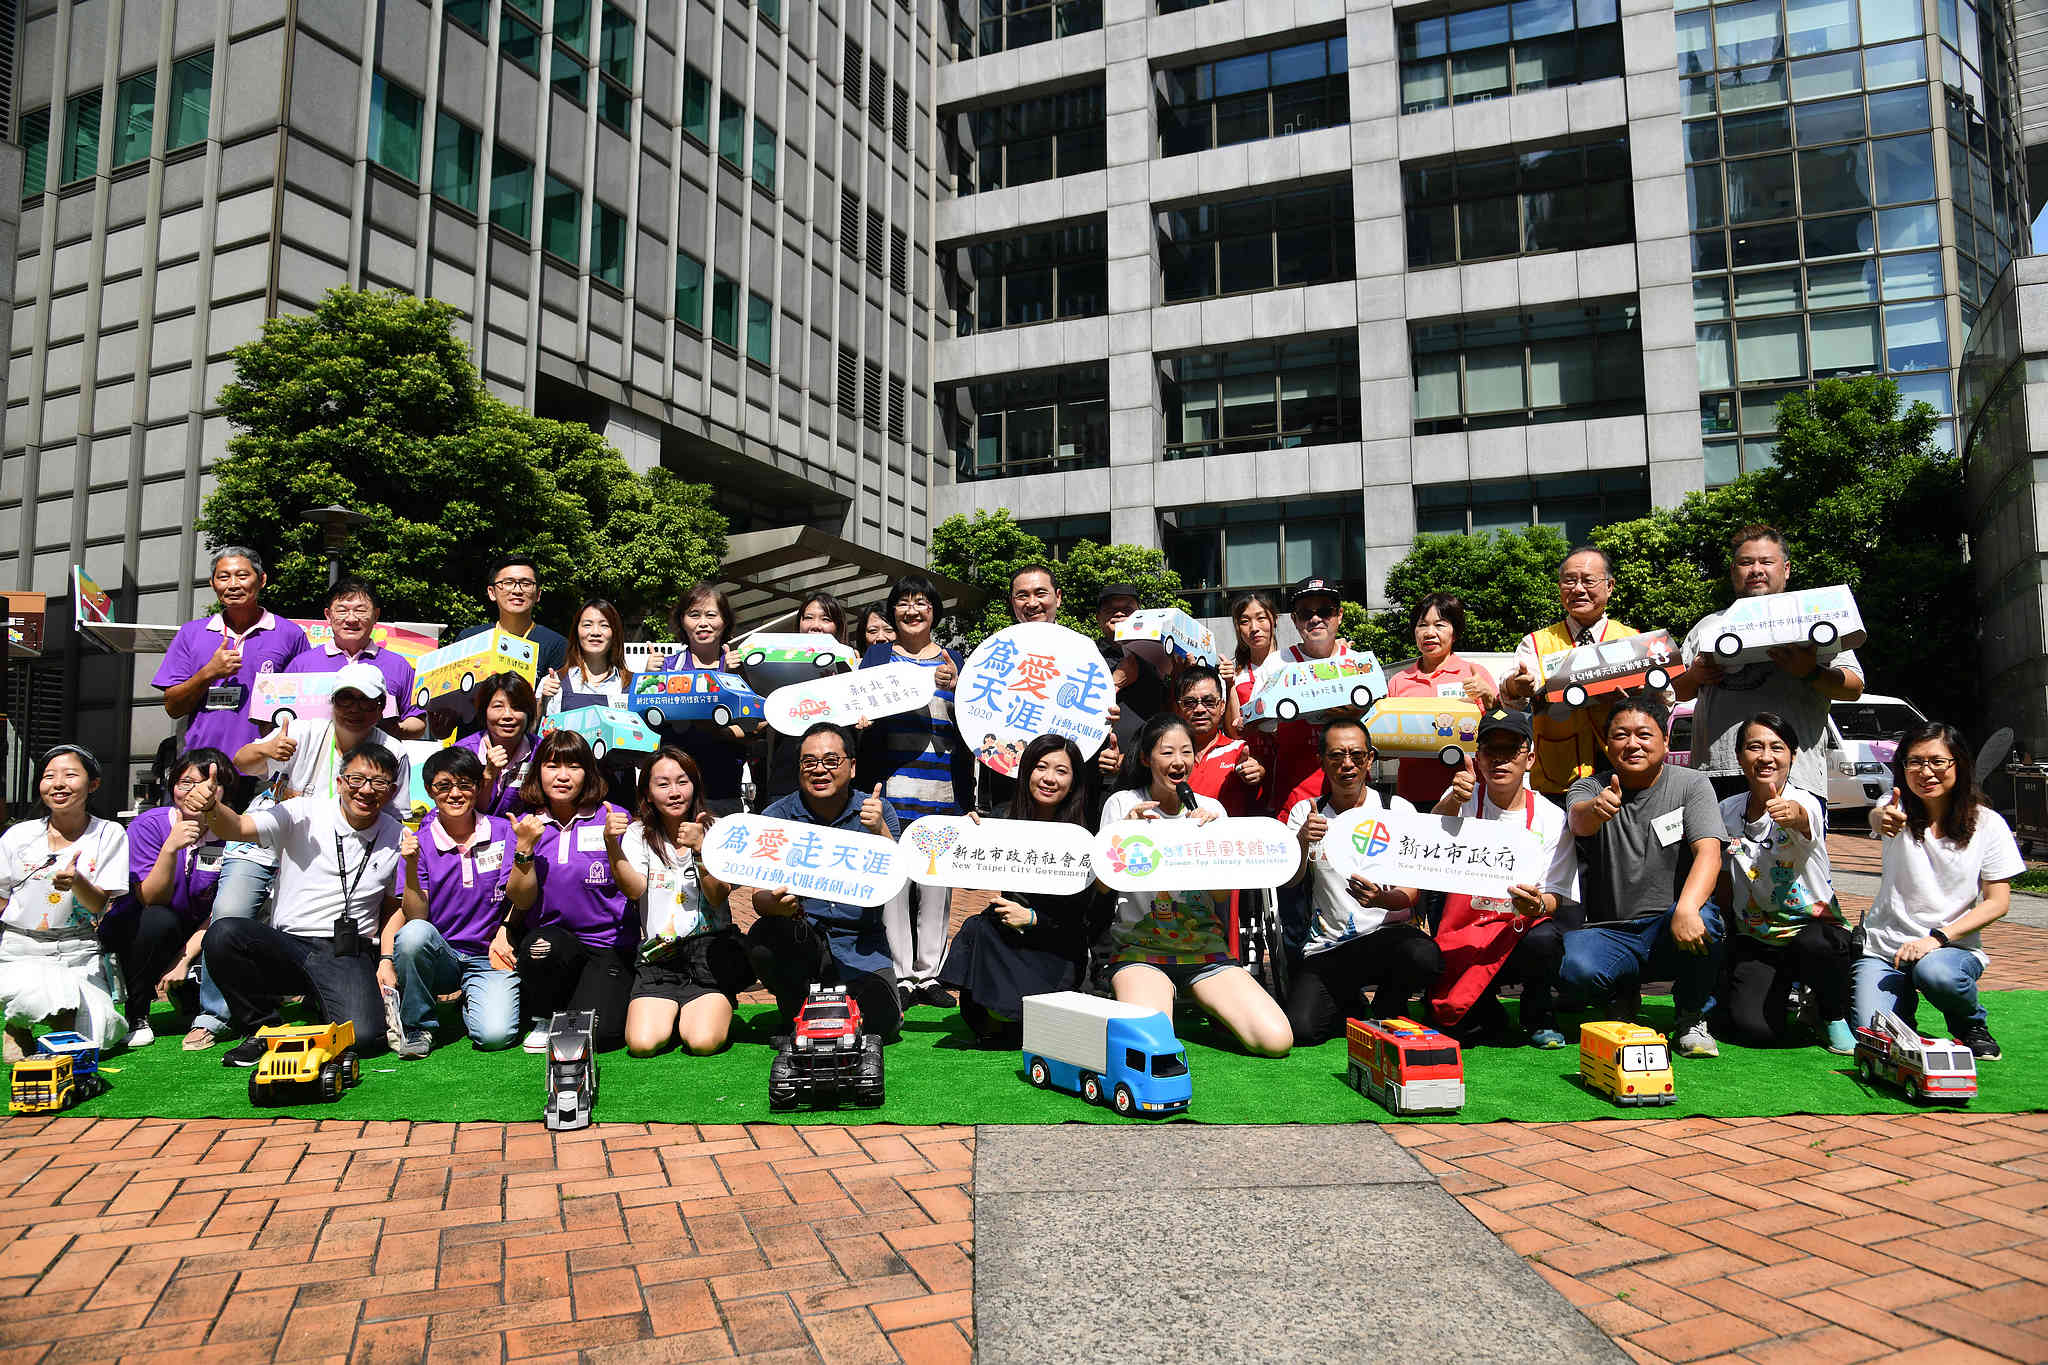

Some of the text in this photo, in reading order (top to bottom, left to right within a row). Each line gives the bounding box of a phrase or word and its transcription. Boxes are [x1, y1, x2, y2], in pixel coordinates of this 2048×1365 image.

[968, 705, 993, 721] 2020
[953, 844, 1092, 868] 新北市政府社會局
[1398, 835, 1515, 871] 新北市政府
[952, 861, 971, 870] New
[976, 863, 1006, 873] Taipei
[1011, 865, 1031, 875] City
[1397, 861, 1514, 881] New Taipei City Government
